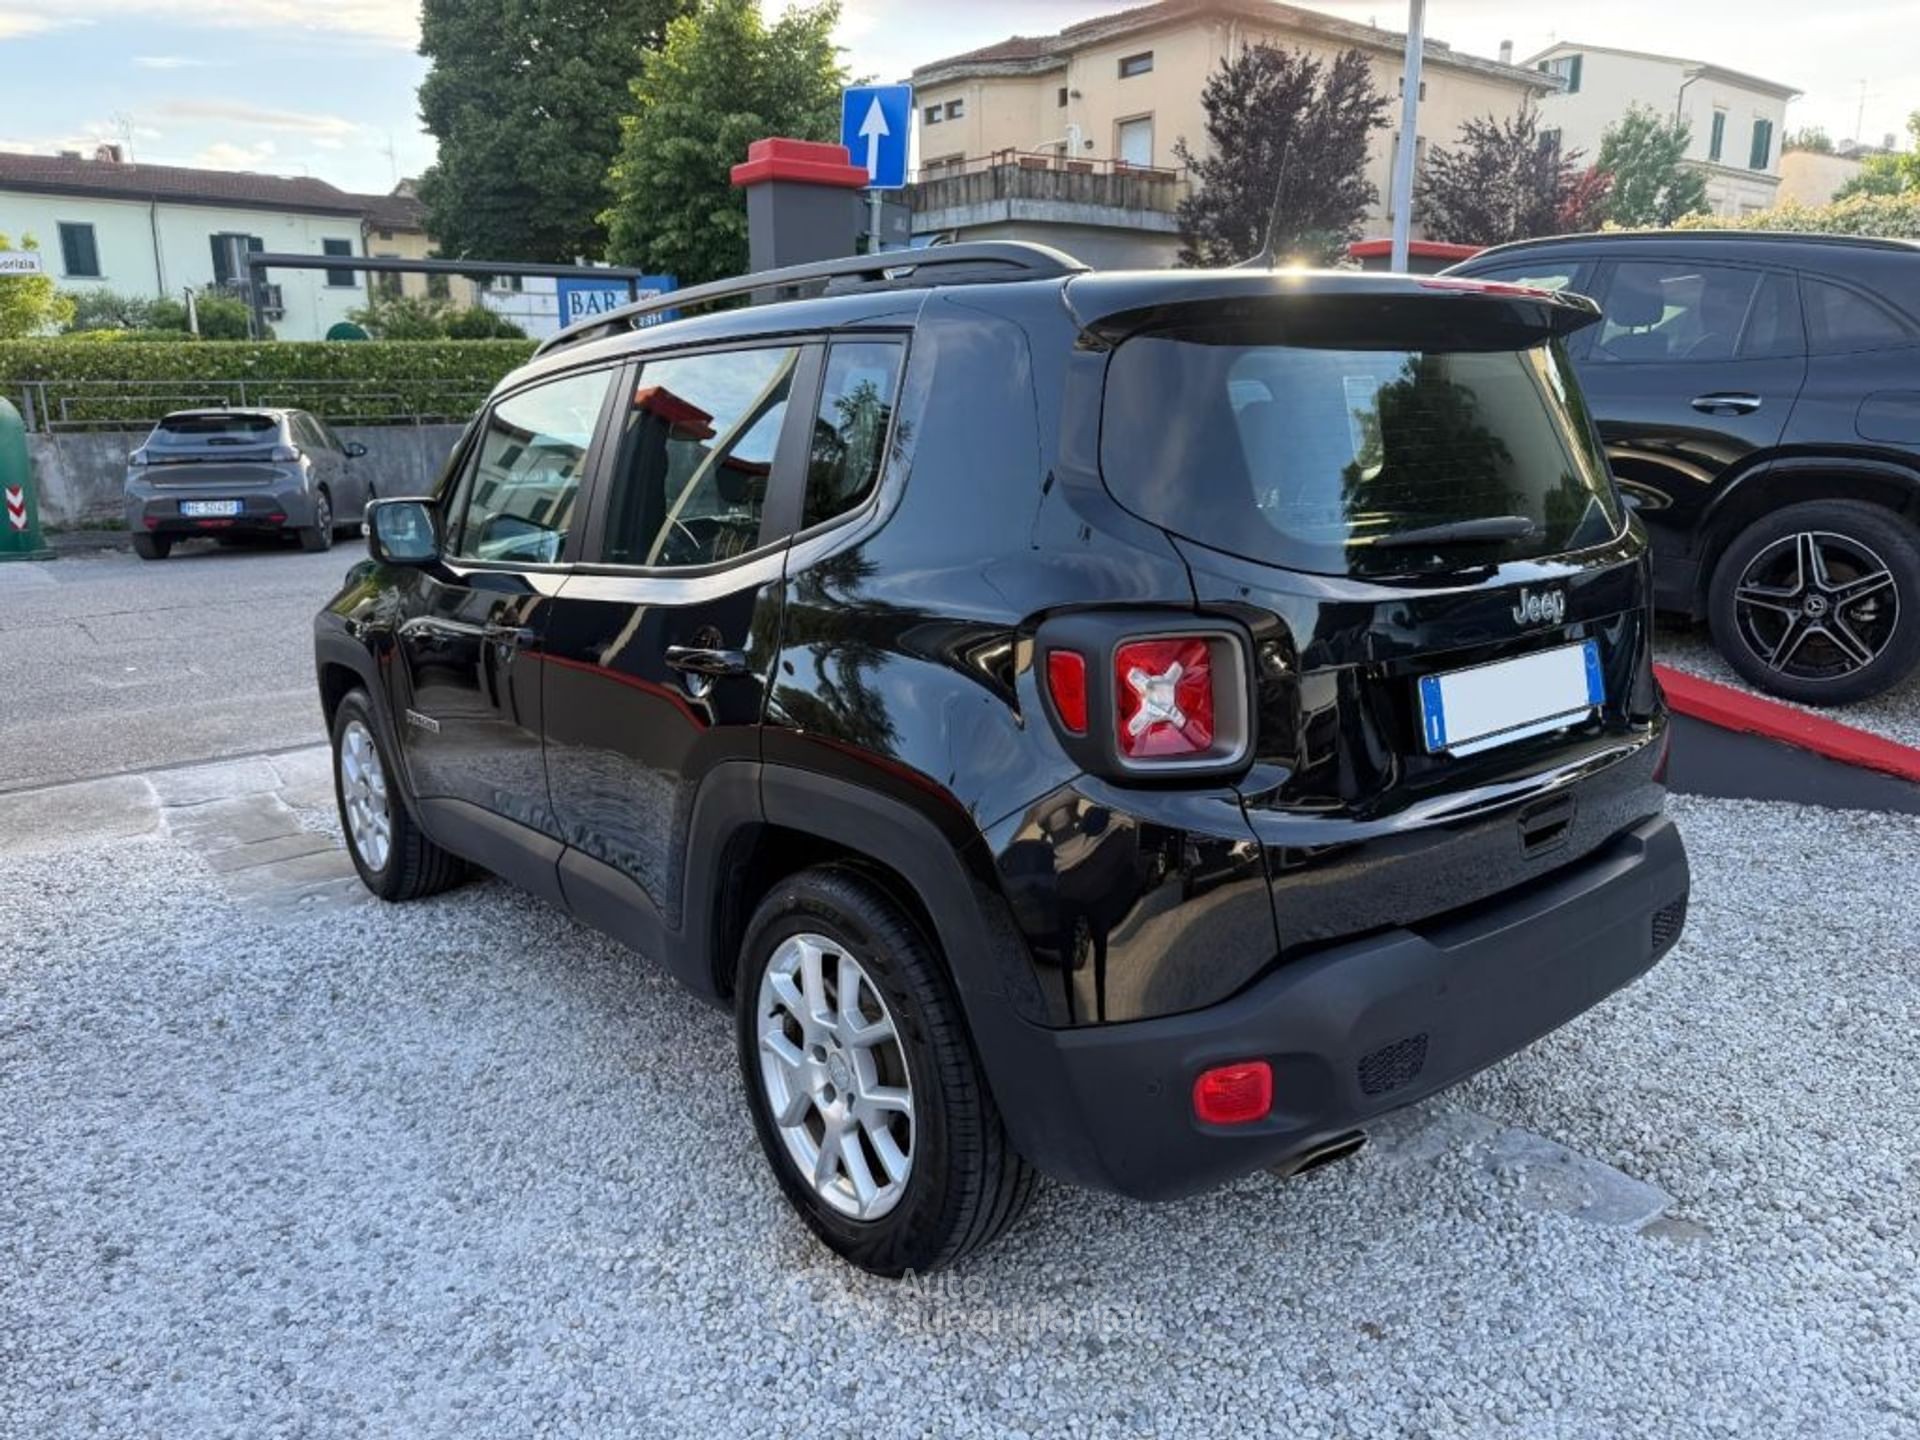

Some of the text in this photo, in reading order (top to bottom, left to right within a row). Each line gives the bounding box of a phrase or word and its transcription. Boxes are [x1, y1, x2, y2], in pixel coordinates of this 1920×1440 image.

[0, 259, 35, 269] orizia
[571, 292, 616, 315] BAR
[1513, 588, 1564, 624] Jeep
